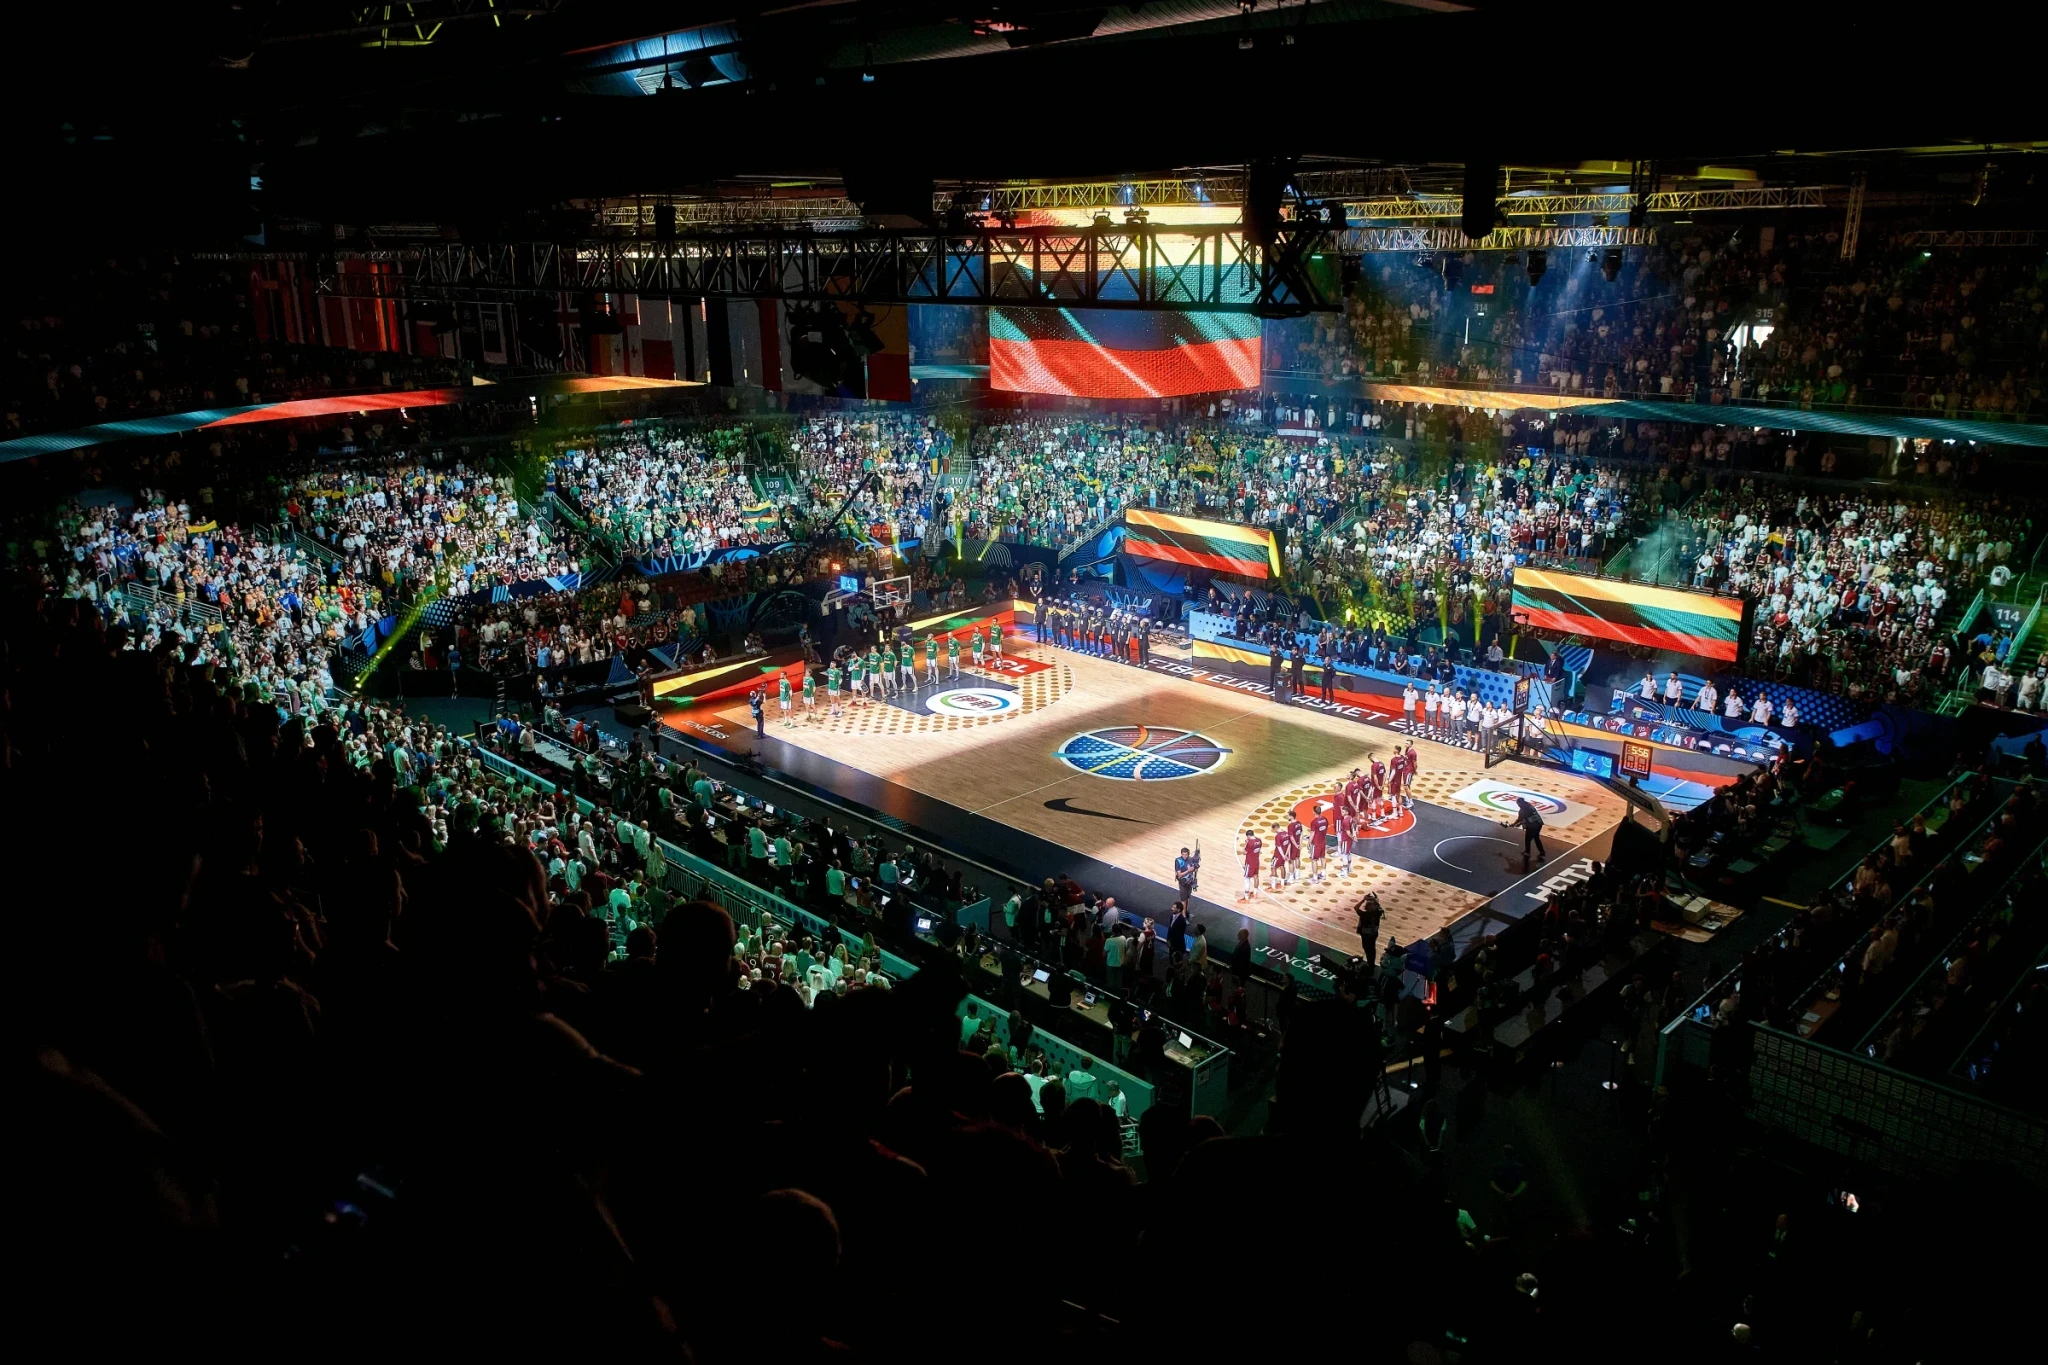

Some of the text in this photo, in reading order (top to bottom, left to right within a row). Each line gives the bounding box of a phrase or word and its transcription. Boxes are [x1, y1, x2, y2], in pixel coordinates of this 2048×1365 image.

[1474, 303, 1488, 312] 314
[1755, 308, 1774, 318] 315
[765, 481, 780, 489] 109
[951, 477, 963, 485] 110
[1996, 608, 2021, 622] 114
[1148, 658, 1390, 722] FIBA EUROASKET
[1631, 746, 1649, 757] 5:56
[1255, 945, 1338, 981] JUNCKE
